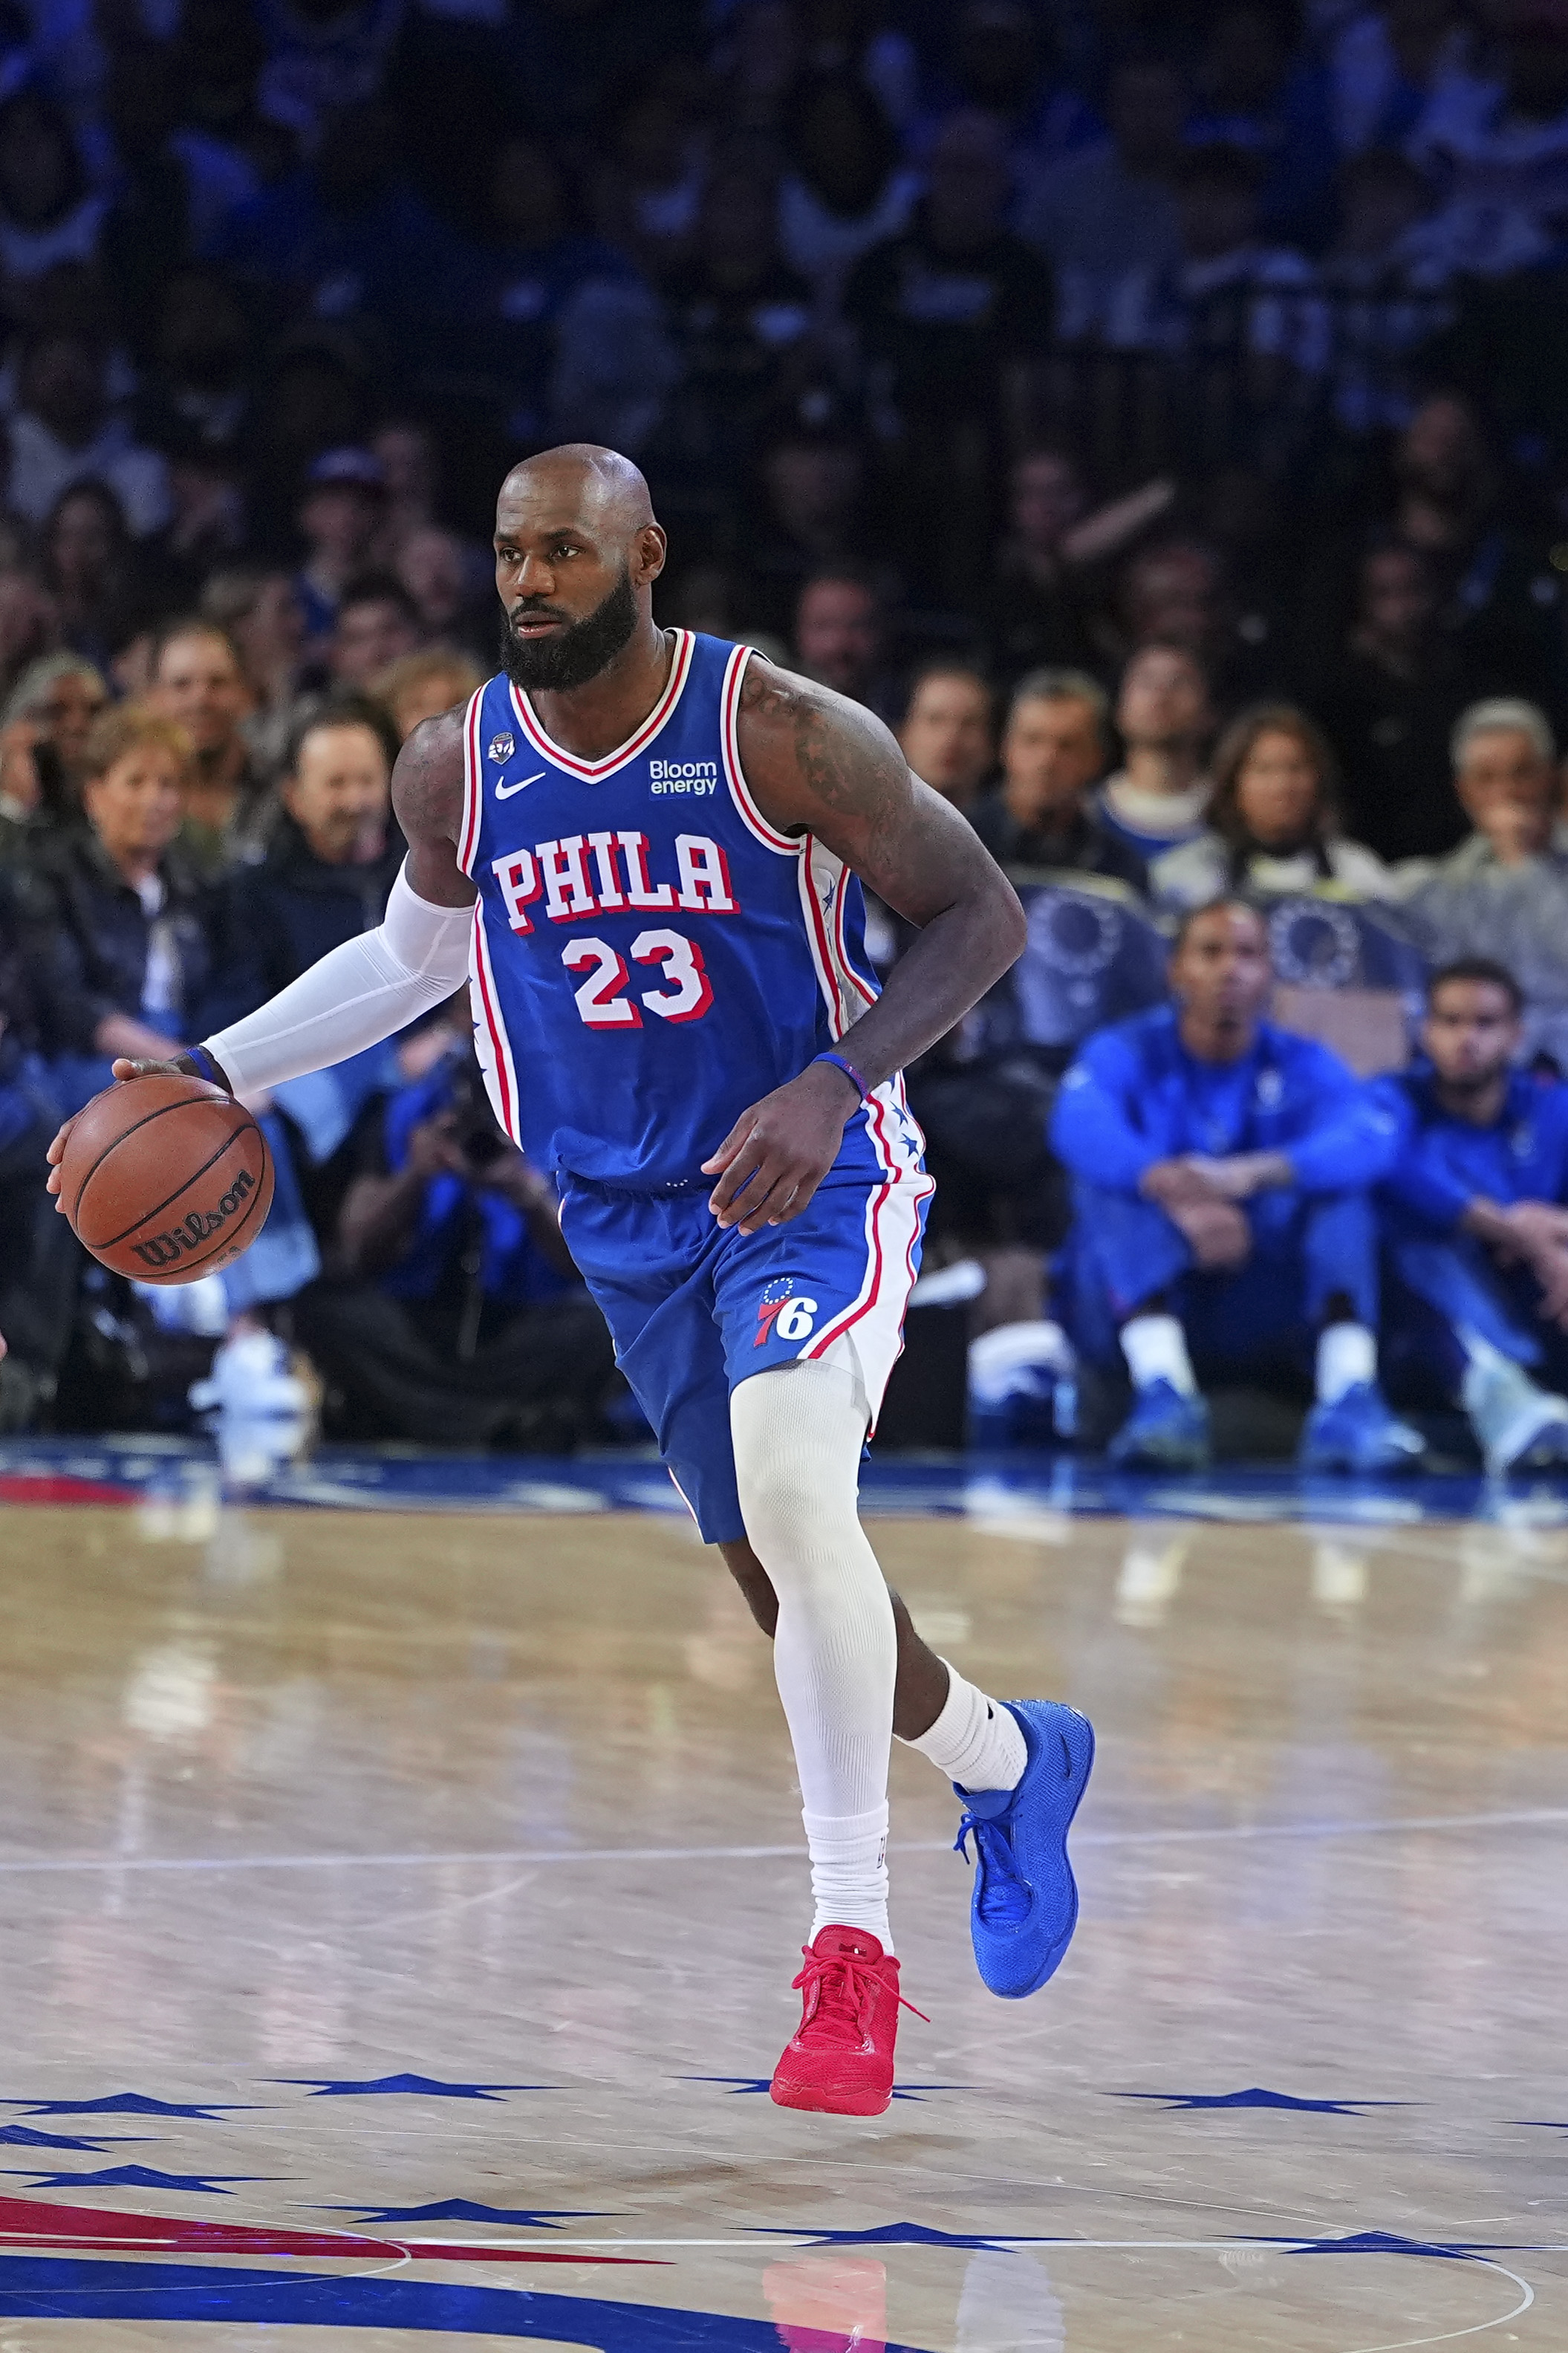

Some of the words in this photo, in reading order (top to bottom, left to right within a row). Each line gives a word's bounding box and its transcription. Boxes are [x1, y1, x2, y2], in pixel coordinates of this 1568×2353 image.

[649, 759, 718, 779] Bloom
[651, 777, 718, 796] energy
[491, 831, 741, 936] PHILA
[561, 928, 715, 1031] 23
[129, 1168, 256, 1267] Wilson
[753, 1296, 819, 1348] 76
